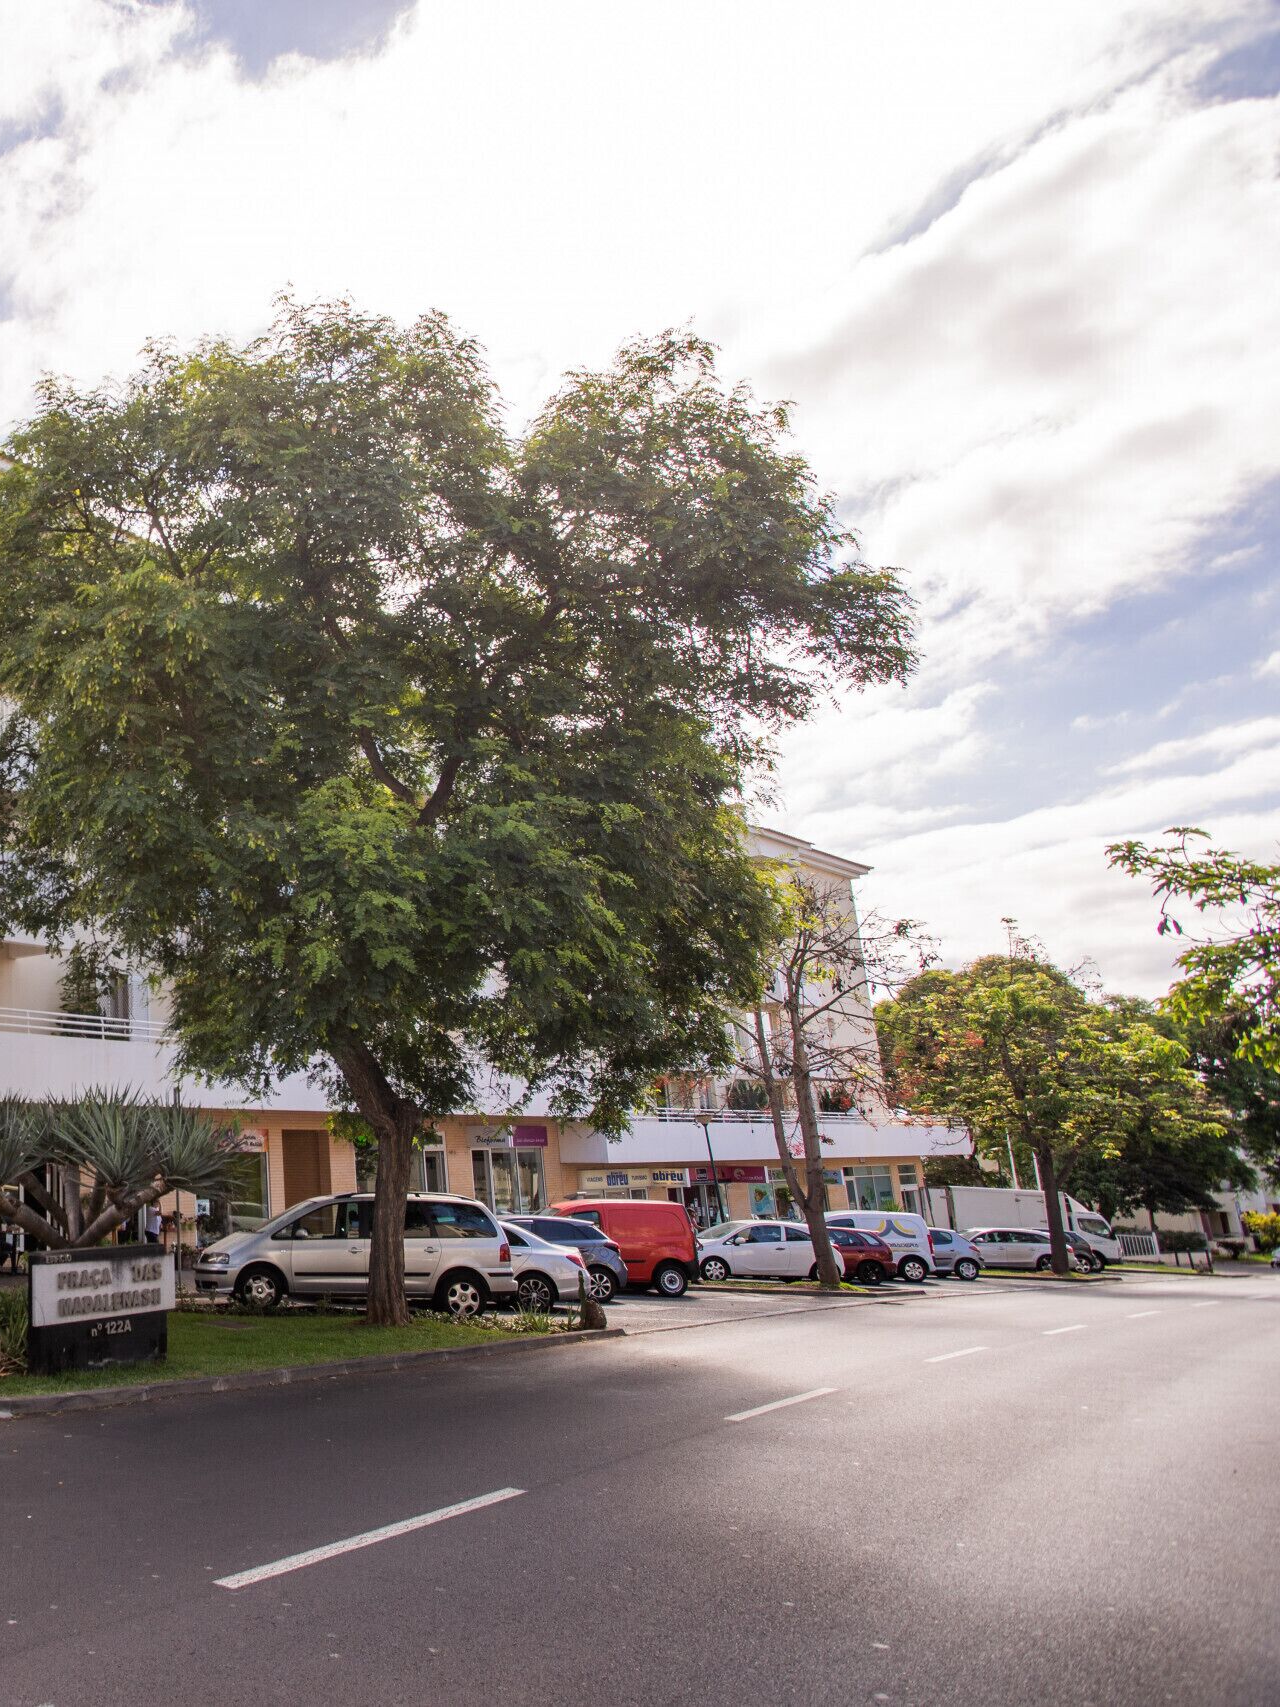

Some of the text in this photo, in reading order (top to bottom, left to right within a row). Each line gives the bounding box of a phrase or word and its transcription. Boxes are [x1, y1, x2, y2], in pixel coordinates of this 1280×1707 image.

[606, 1173, 629, 1187] abreu
[652, 1170, 684, 1182] abreu
[57, 1262, 163, 1290] PRAÇA DAS
[105, 1319, 132, 1335] 122A
